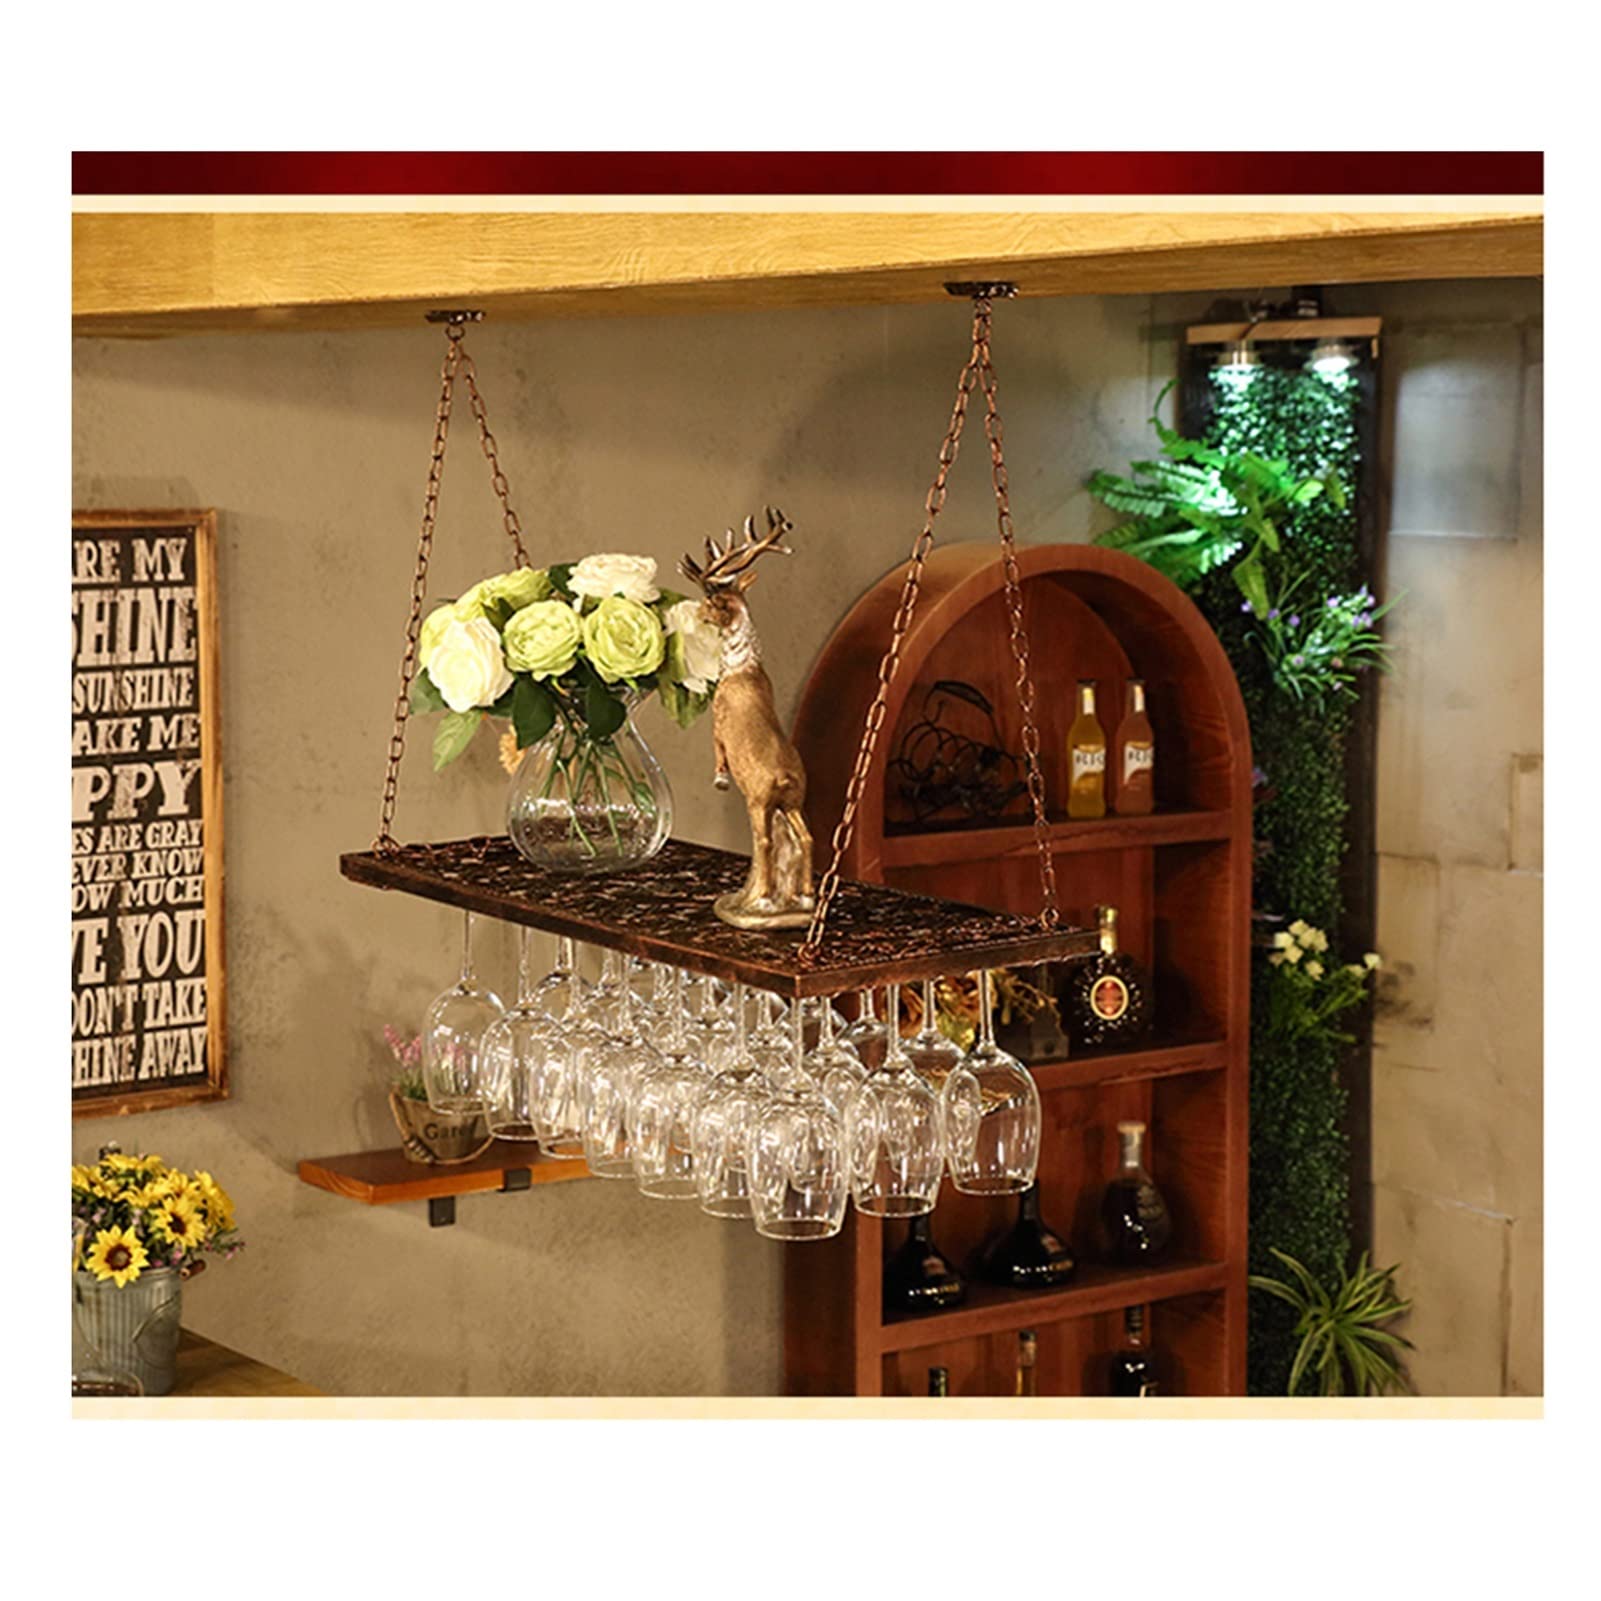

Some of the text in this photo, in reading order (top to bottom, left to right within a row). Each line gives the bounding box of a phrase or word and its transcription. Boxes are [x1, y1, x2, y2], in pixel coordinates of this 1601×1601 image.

[72, 538, 187, 583] RE MY
[72, 668, 194, 714] SUNSHINE
[72, 714, 200, 756] AKE ME
[72, 758, 202, 822] PPY
[97, 823, 142, 853] ARE
[146, 819, 202, 849] GRAY
[72, 847, 203, 883] EVER KNOW
[118, 875, 203, 908] MUCH
[117, 909, 206, 980] YOU
[72, 977, 206, 1036] ON'T TAKE
[138, 1026, 207, 1080] AWAY
